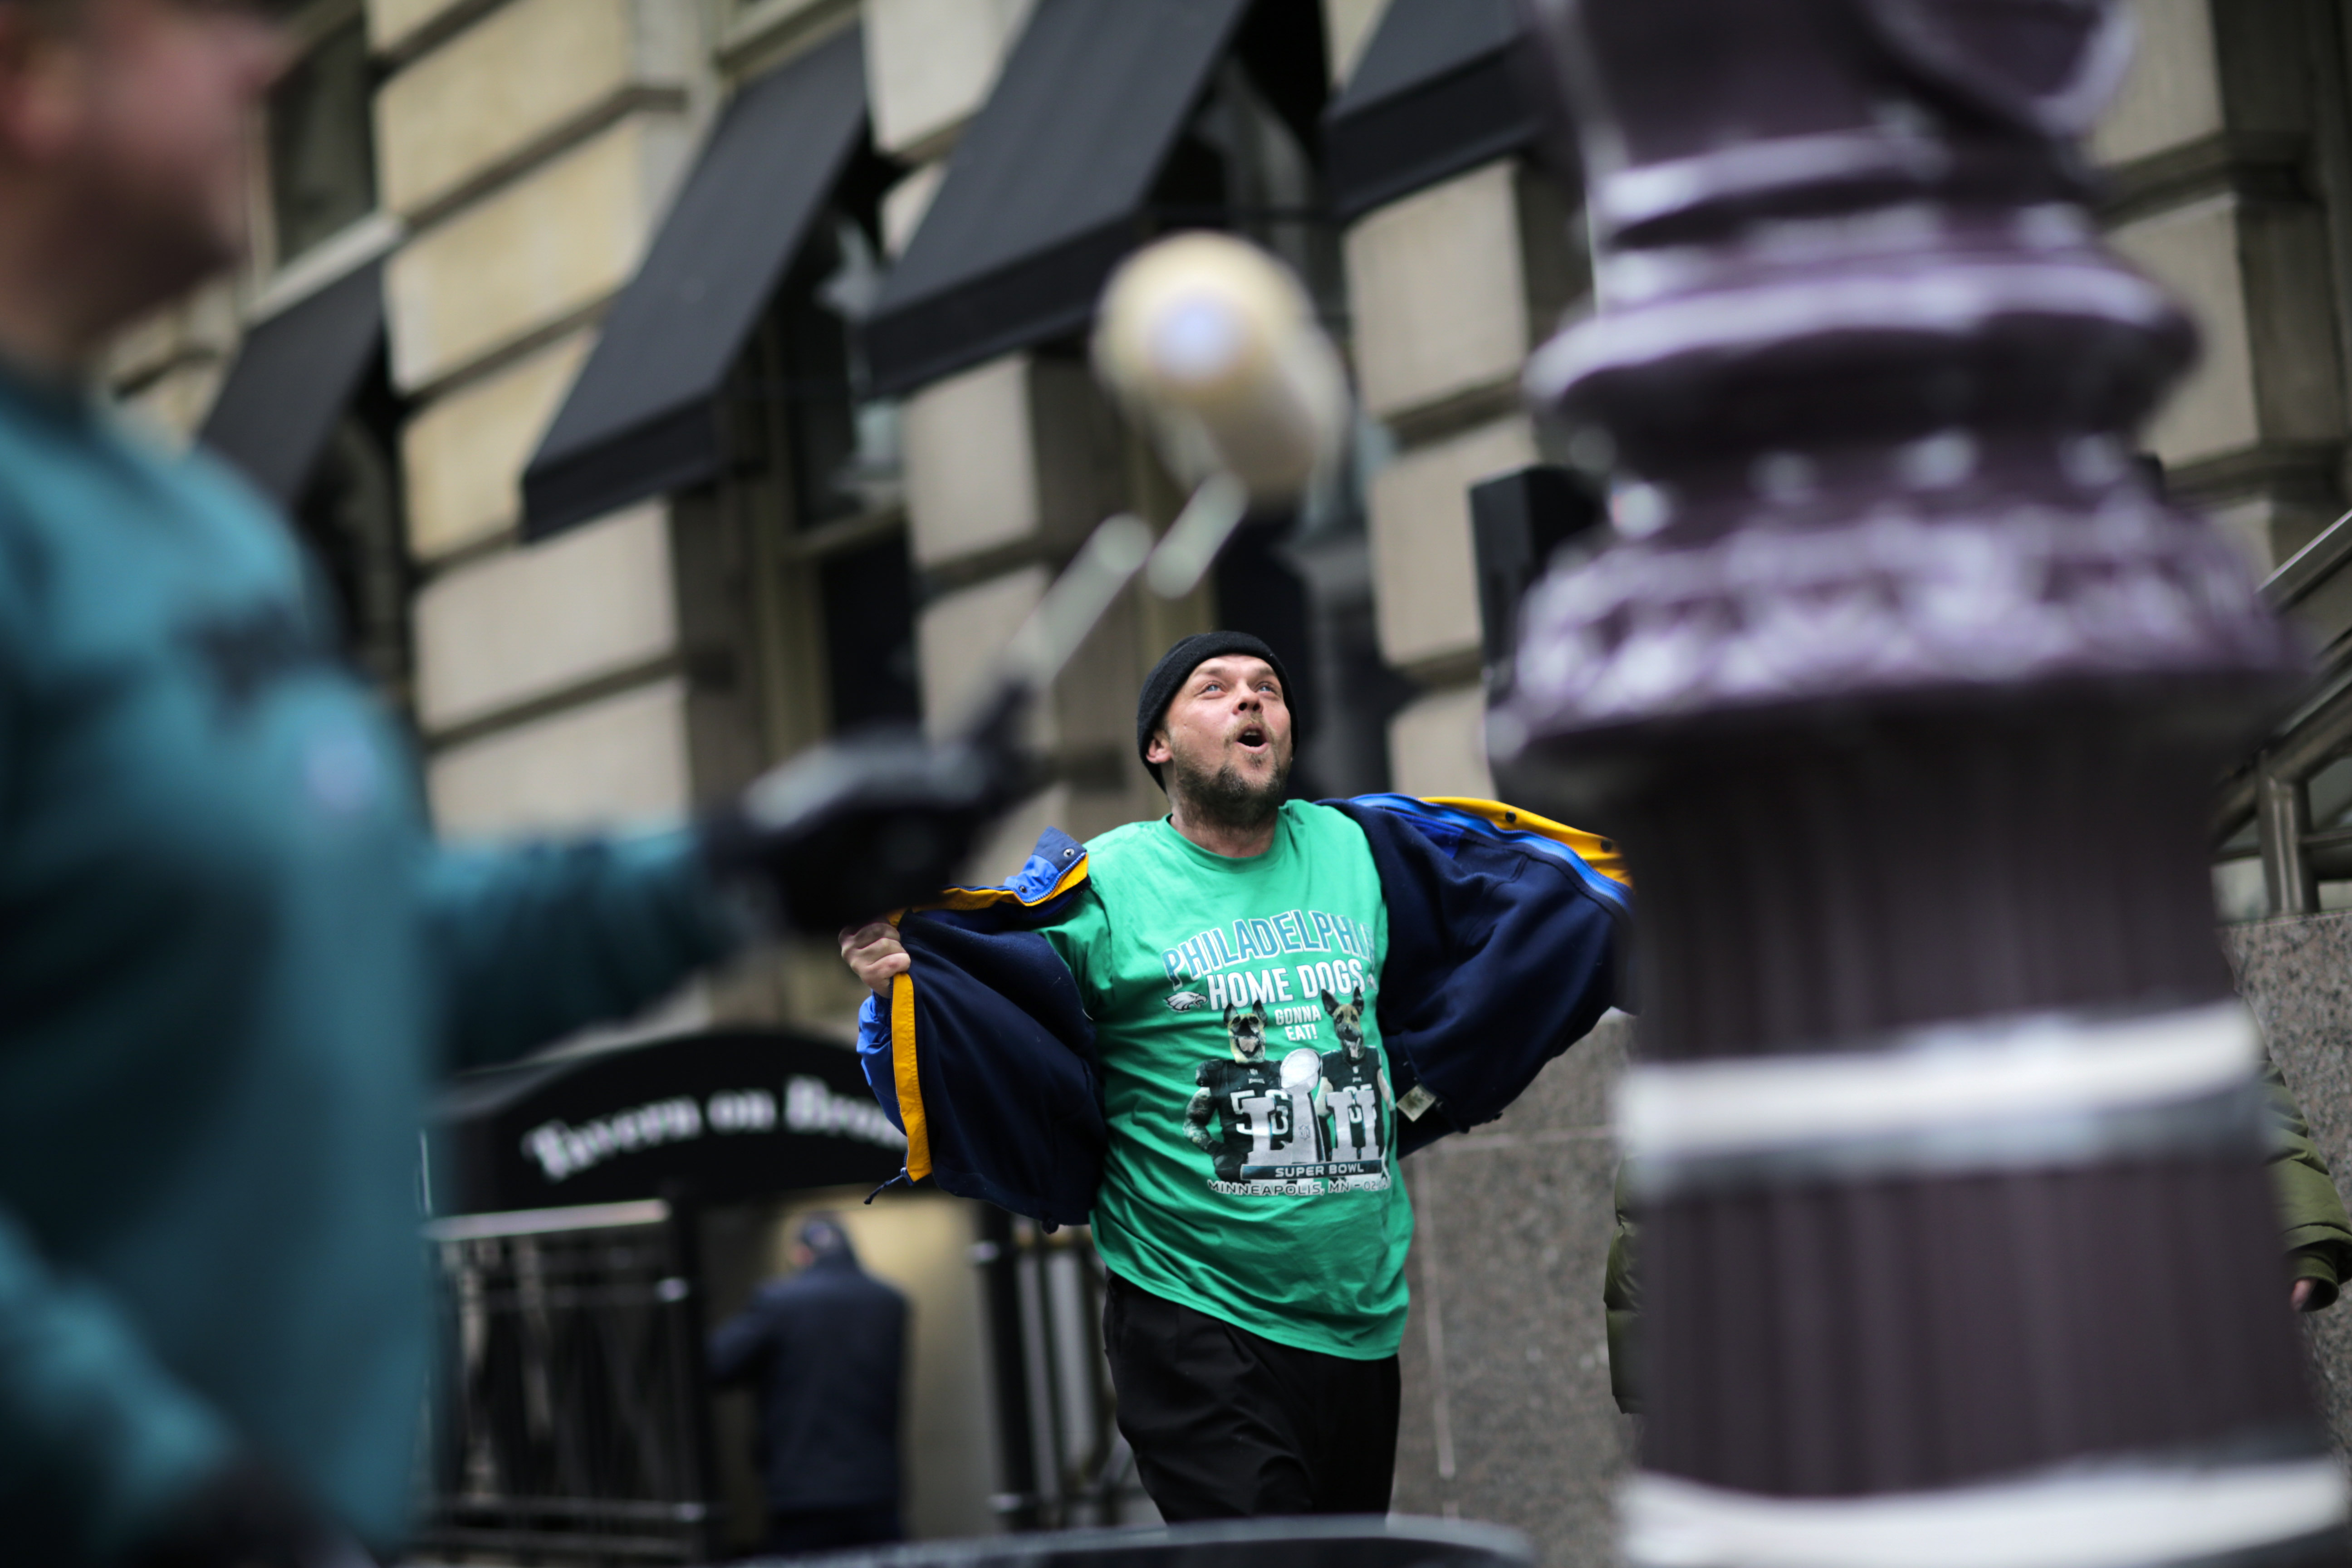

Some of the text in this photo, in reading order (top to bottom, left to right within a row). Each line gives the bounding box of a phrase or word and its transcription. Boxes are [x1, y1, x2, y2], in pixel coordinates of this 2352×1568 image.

[1207, 958, 1366, 1011] HOME DOGS
[1274, 1005, 1321, 1026] GONNA
[1285, 1024, 1318, 1041] EAT!
[524, 1096, 700, 1178] Tavern
[706, 1091, 775, 1132] on
[1275, 1162, 1364, 1177] SUPER BOWL
[1207, 1179, 1325, 1196] MINNEAPOLIS,
[1328, 1180, 1350, 1194] MN
